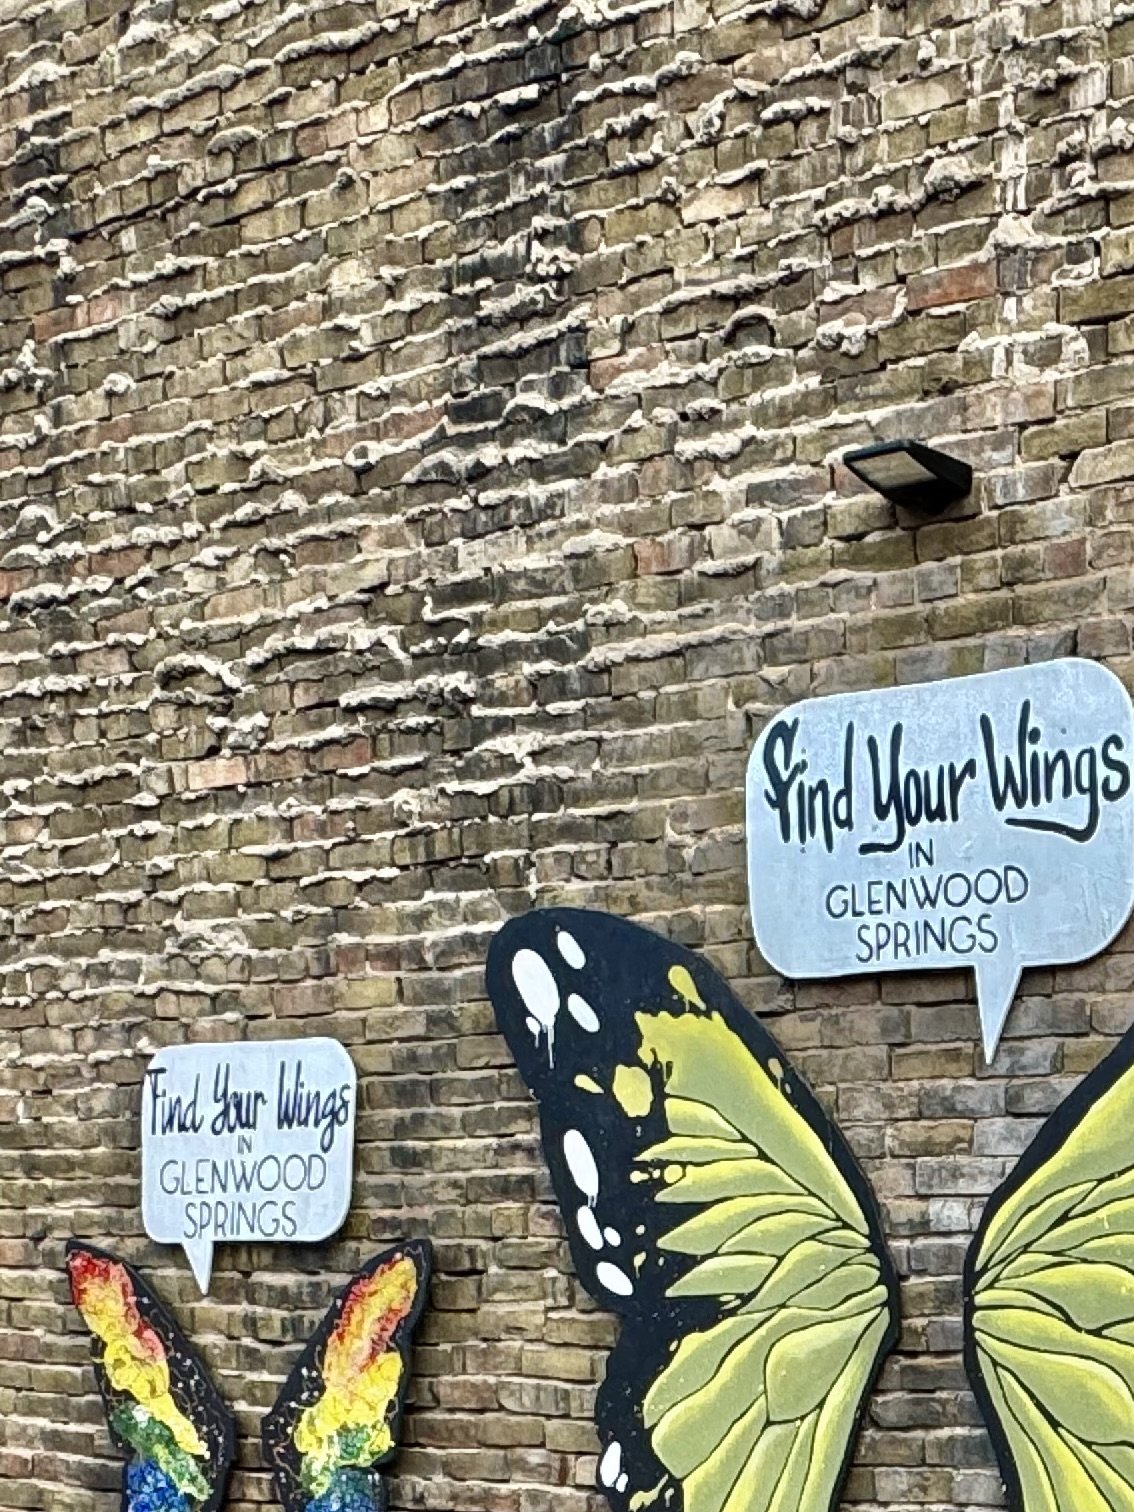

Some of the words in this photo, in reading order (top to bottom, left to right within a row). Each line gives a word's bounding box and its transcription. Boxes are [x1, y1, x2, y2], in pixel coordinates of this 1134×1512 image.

[859, 721, 977, 856] Your
[979, 698, 1131, 843] Wings
[908, 838, 934, 869] IN
[825, 864, 1029, 919] GLENWOOD
[855, 913, 998, 964] SPRINGS
[145, 1066, 205, 1136] Find
[211, 1062, 267, 1136] Your
[277, 1059, 351, 1154] Wings
[237, 1134, 253, 1154] IN
[159, 1153, 327, 1196] GLENWOOD
[183, 1200, 298, 1240] SPRINGS
